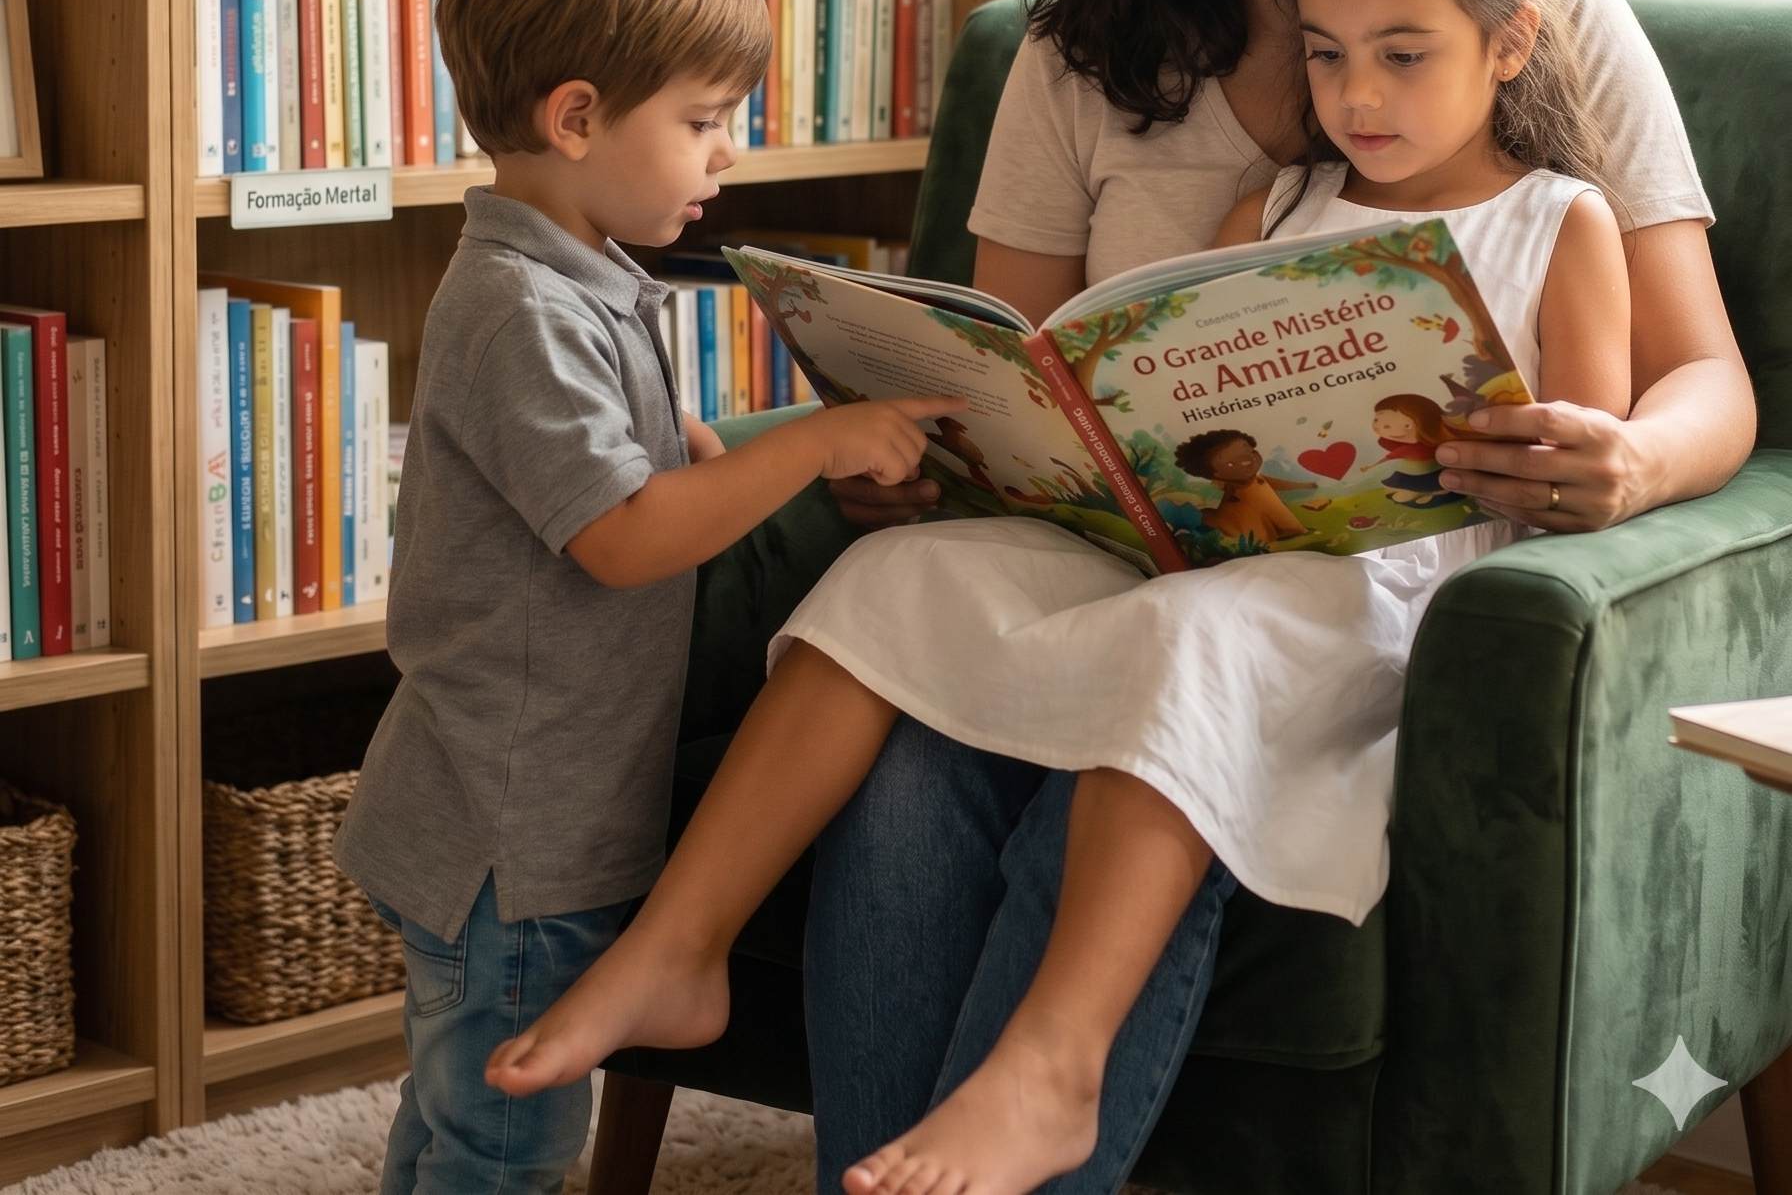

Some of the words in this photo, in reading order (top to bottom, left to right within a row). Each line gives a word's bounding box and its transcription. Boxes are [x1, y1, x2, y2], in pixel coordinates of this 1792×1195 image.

[247, 188, 322, 211] Formação
[1133, 355, 1157, 376] O
[1163, 328, 1269, 368] Grande
[1272, 292, 1396, 340] Mistério
[1172, 380, 1209, 402] da
[1217, 327, 1389, 393] Amizade
[1181, 396, 1262, 424] Histórias
[1264, 385, 1307, 407] para
[1308, 381, 1321, 393] o
[1323, 359, 1398, 389] Coração
